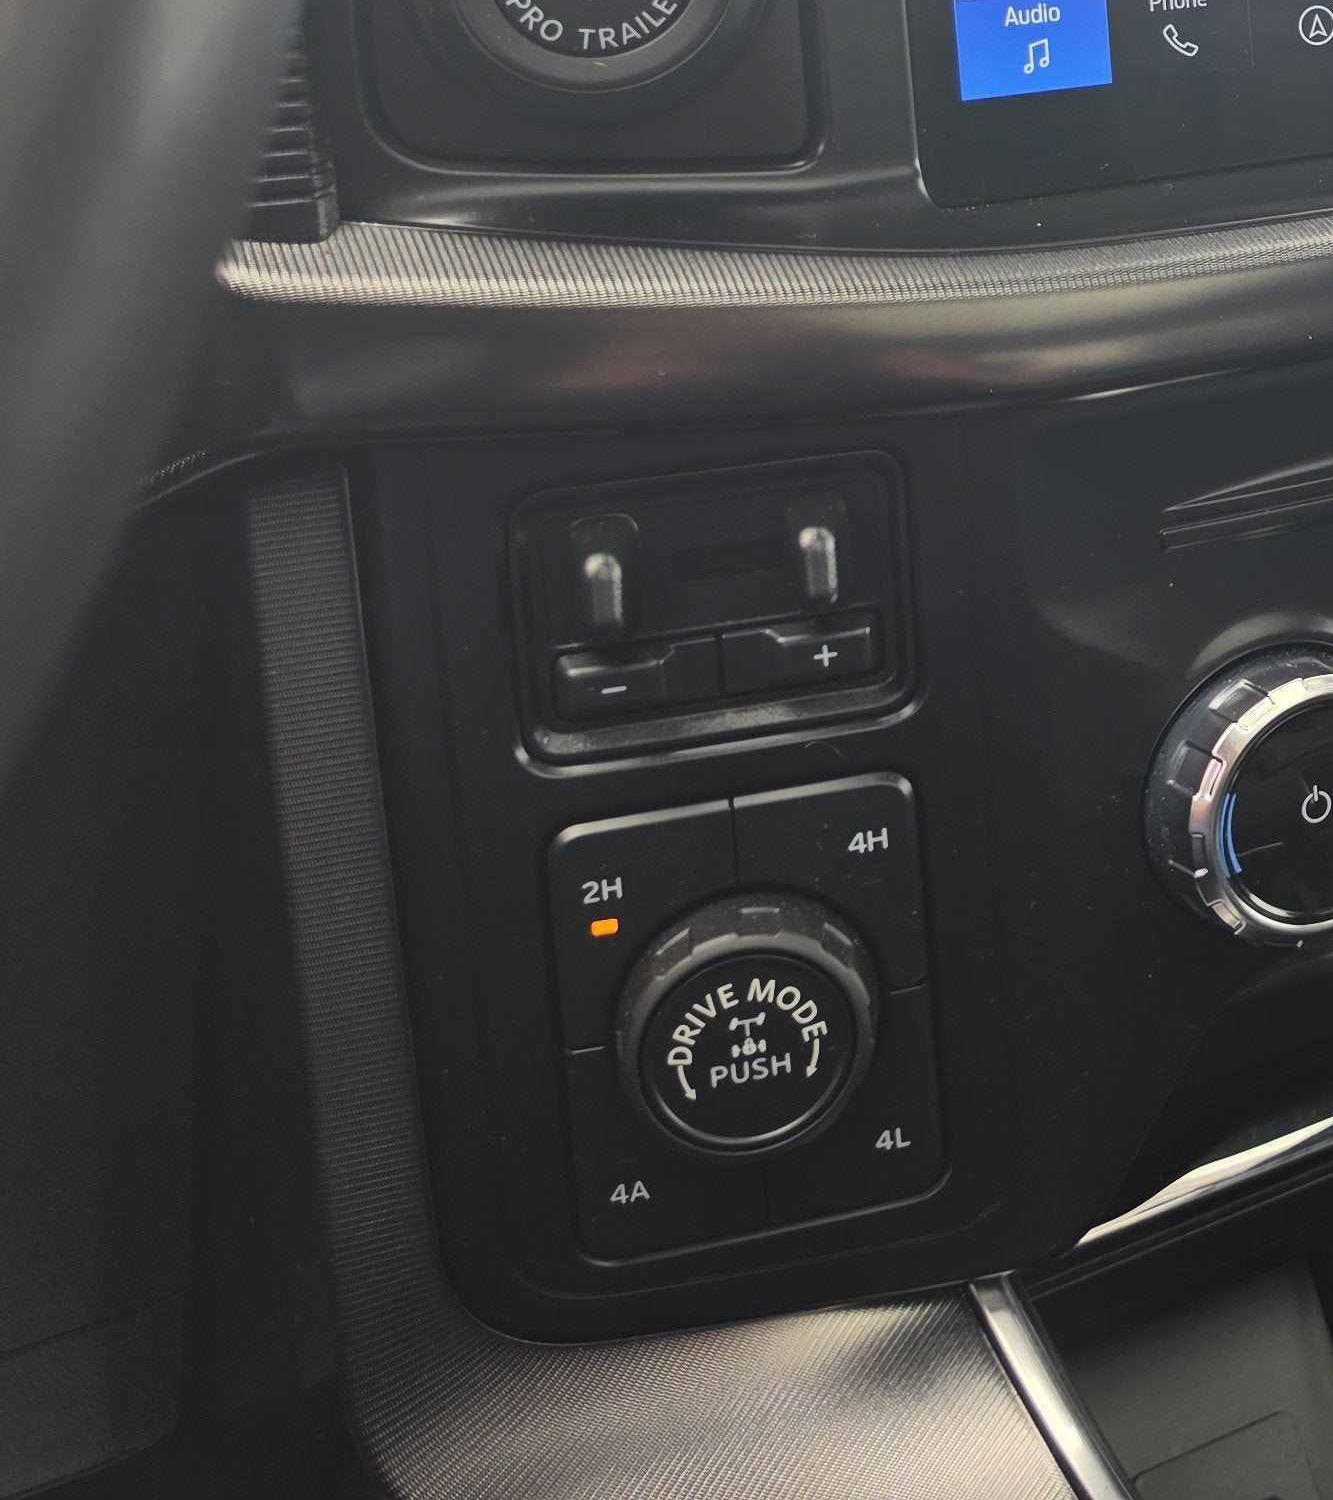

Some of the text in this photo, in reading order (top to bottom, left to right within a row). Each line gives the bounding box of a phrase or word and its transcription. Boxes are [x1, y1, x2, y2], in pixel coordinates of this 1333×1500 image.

[1004, 2, 1061, 27] Audio
[847, 827, 889, 854] 4H
[581, 876, 623, 905] 2H
[667, 977, 828, 1068] DRIVE MODE
[710, 1052, 792, 1088] PUSH
[875, 1127, 912, 1151] 4L
[610, 1180, 651, 1205] 4A
